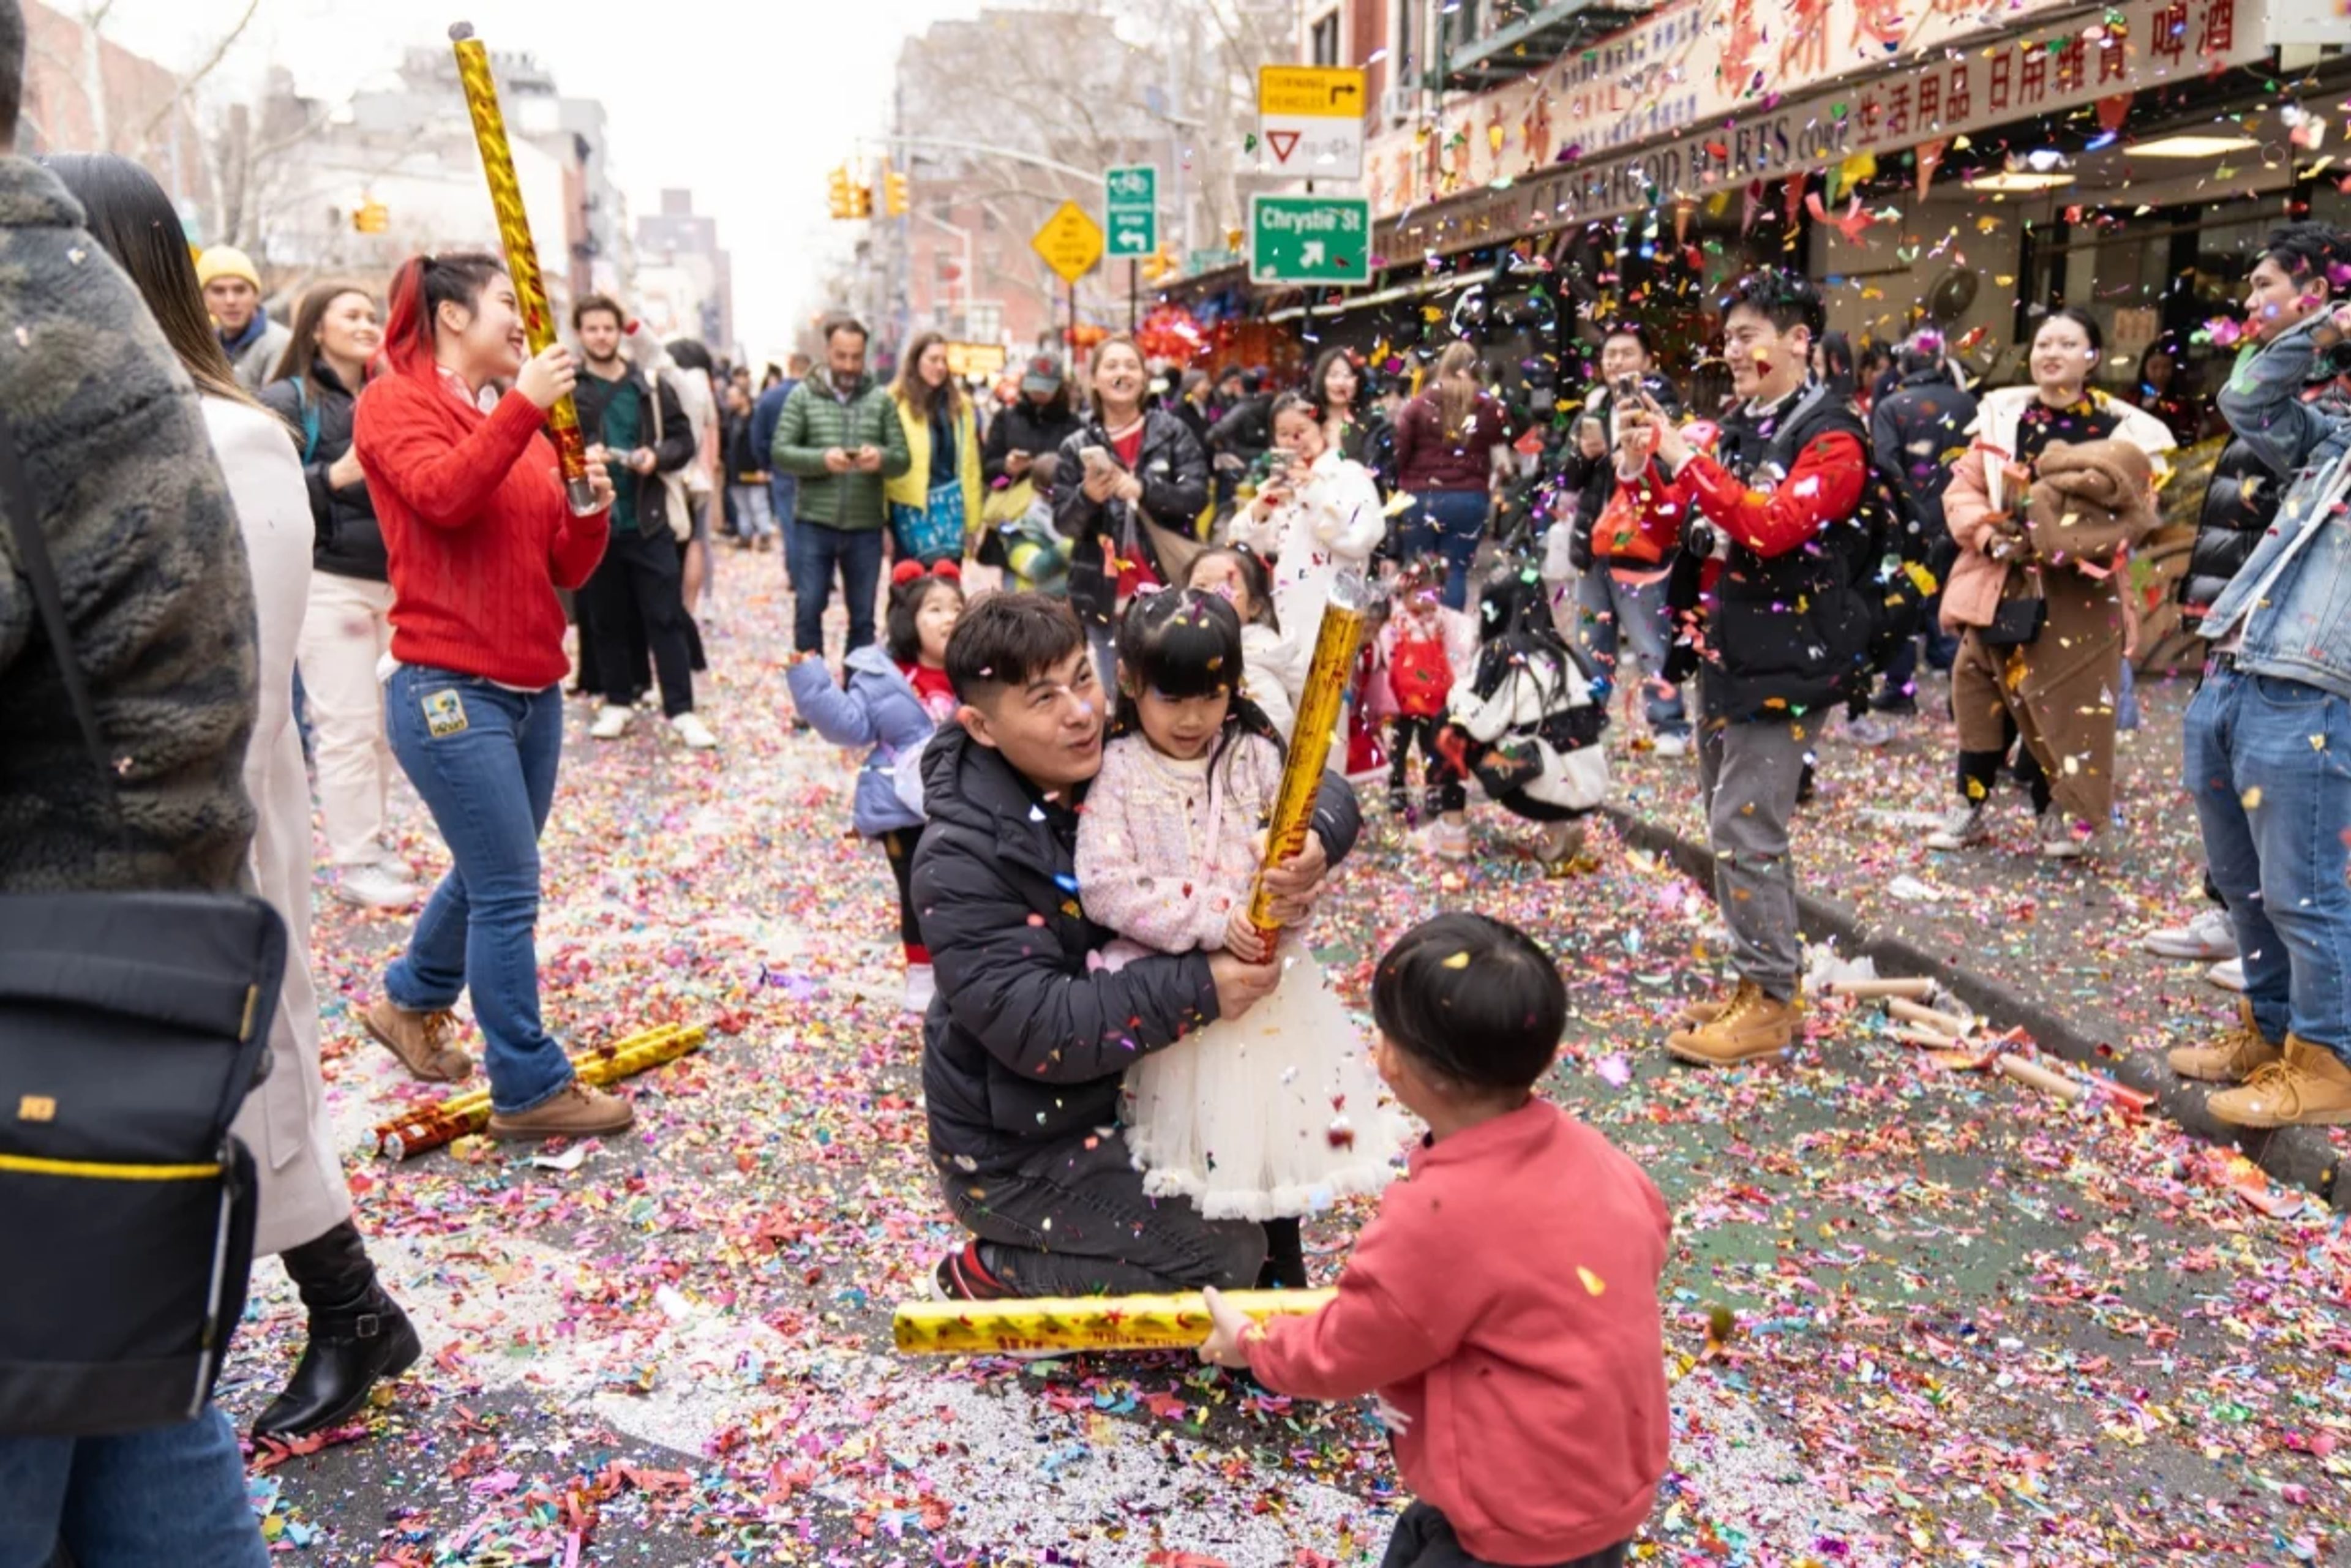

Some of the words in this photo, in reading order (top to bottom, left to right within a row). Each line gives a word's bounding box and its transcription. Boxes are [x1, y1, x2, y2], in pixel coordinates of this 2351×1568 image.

[1857, 66, 1969, 146] 生活用品
[1262, 206, 1337, 235] Chrystie
[1341, 207, 1360, 231] St
